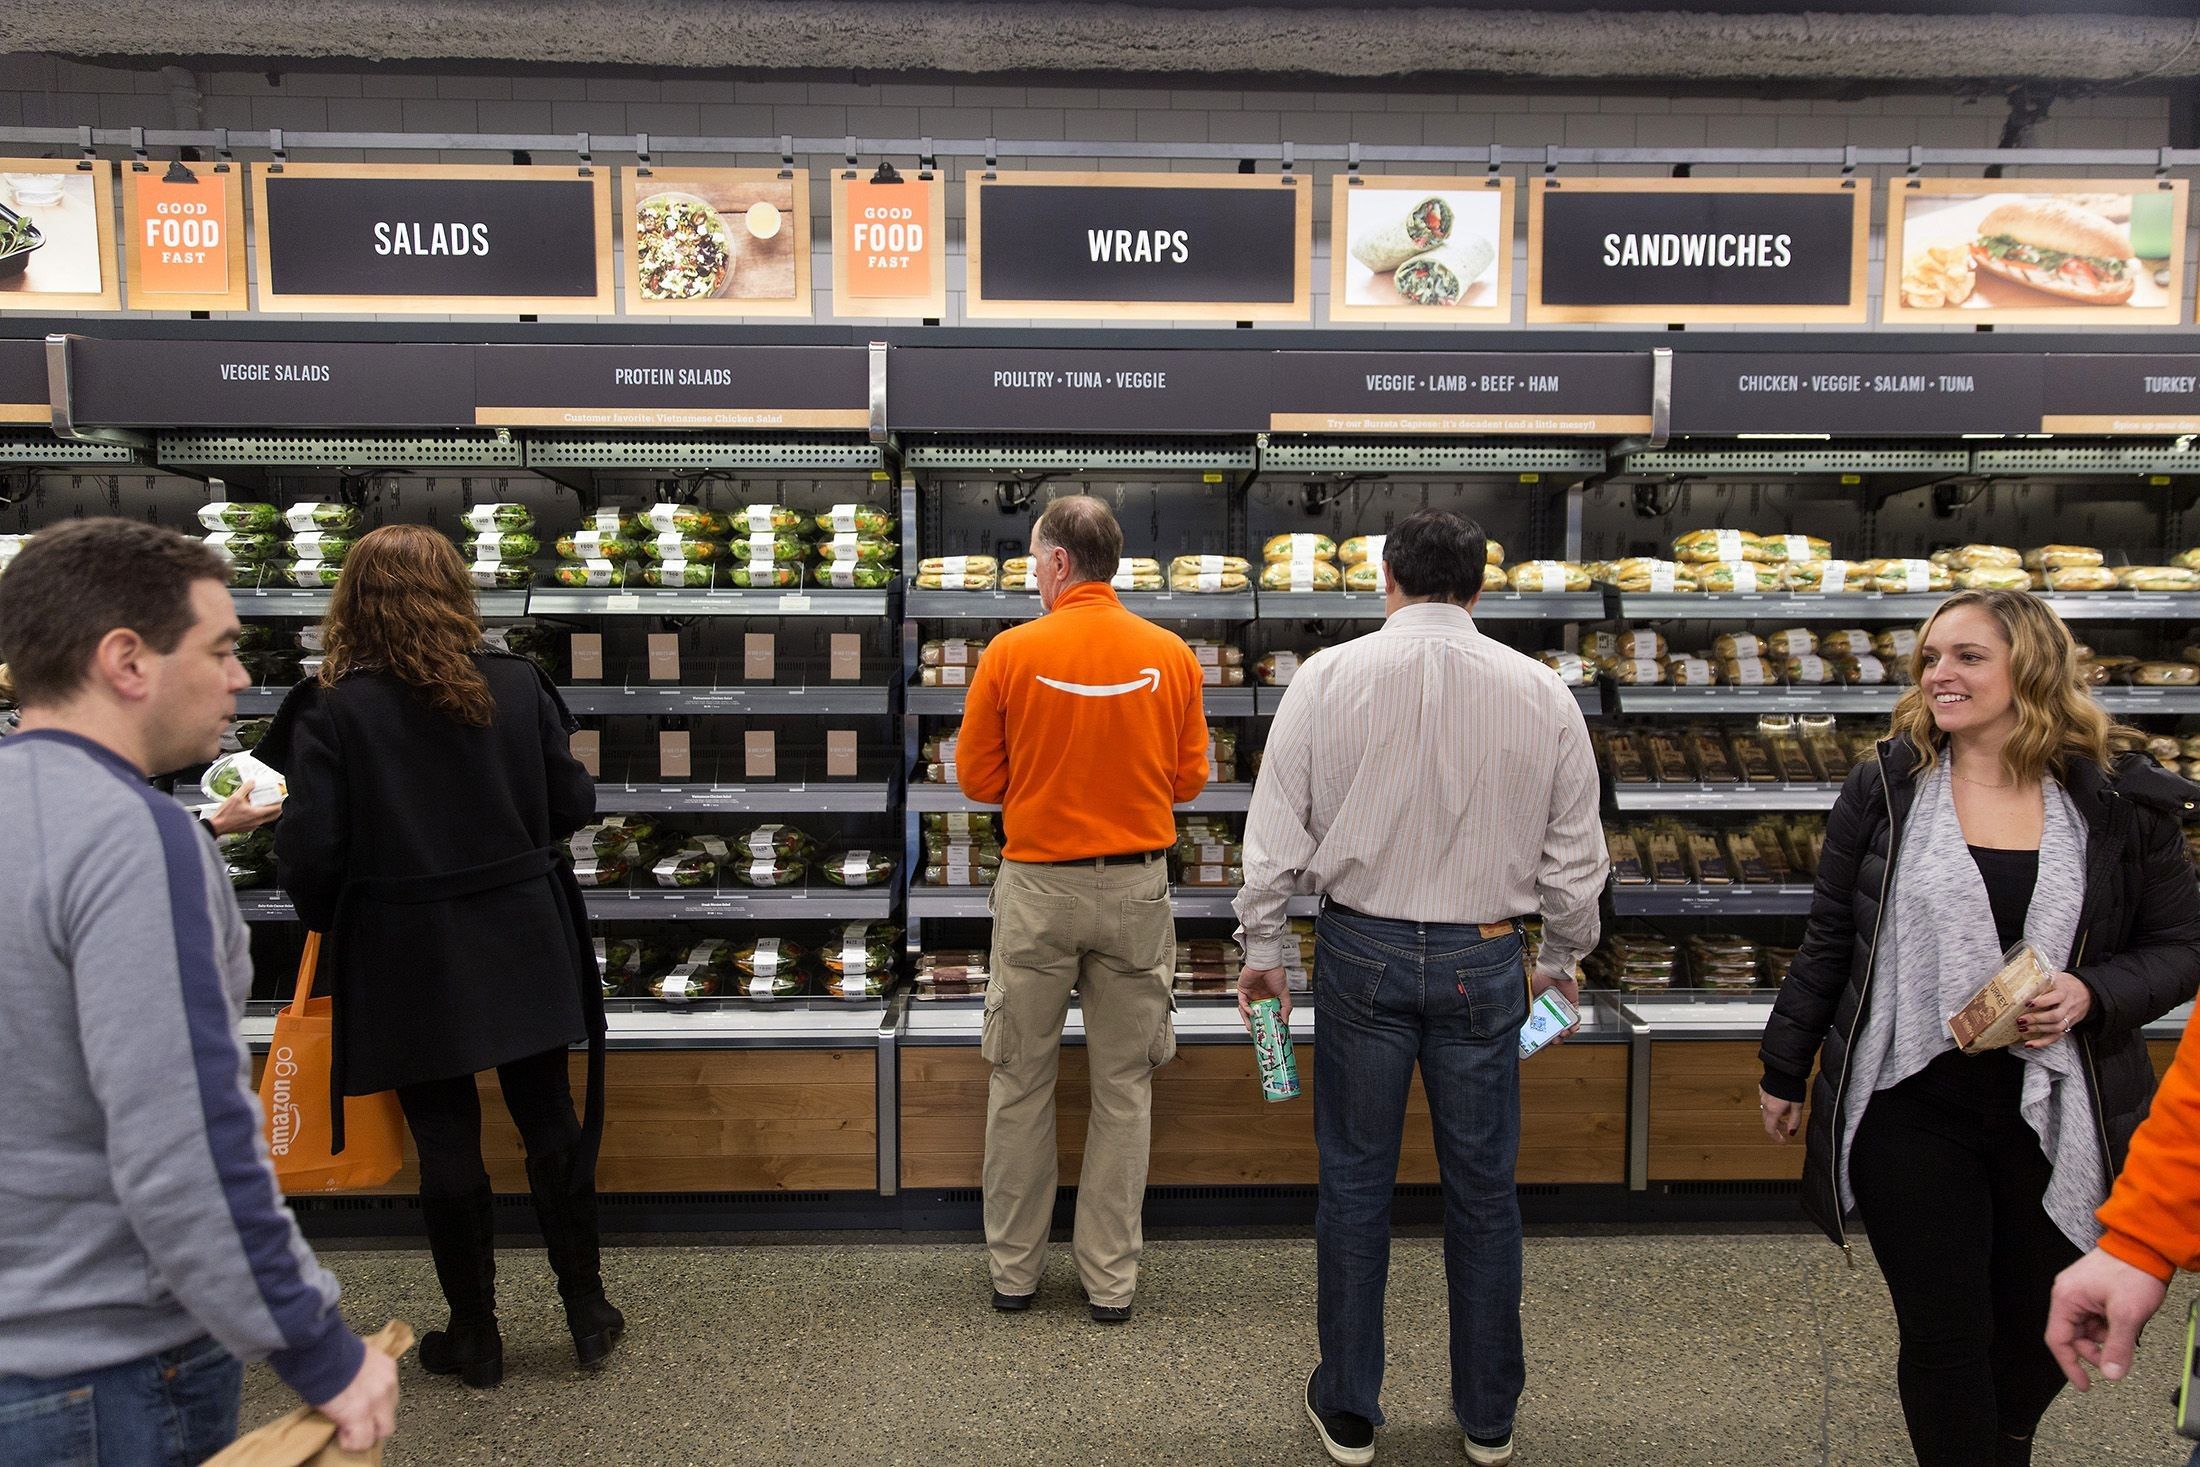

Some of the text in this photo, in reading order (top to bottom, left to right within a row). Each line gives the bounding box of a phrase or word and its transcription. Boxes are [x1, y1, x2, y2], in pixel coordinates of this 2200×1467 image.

[157, 203, 207, 214] GOOD
[865, 207, 912, 219] GOOD
[146, 219, 219, 248] FOOD
[374, 222, 489, 257] SALADS
[854, 223, 923, 252] FOOD
[1088, 230, 1189, 263] WRAPS
[1603, 233, 1792, 267] SANDWICHES
[162, 252, 205, 264] FAST
[868, 256, 909, 268] FAST
[220, 364, 330, 382] VEGGIE SALADS
[615, 368, 732, 386] PROTEIN SALADS
[994, 371, 1166, 389] POULTRY TUNA VEGGIE
[1366, 374, 1559, 392] VEGGIE LAMB BEEF HAM
[1739, 375, 1975, 392] CHICKEN VEGGIE SALAMI TUNA
[2144, 376, 2195, 394] TURKEY
[564, 413, 783, 424] Customer favorite: Vietnamese Chicken Salad
[1327, 419, 1345, 430] Try
[1346, 421, 1362, 429] our
[1458, 420, 1503, 430] decadent
[1504, 419, 1527, 430] (and
[1535, 420, 1558, 430] little
[1989, 981, 2009, 1008] TURKEY
[272, 1046, 298, 1156] amazon go
